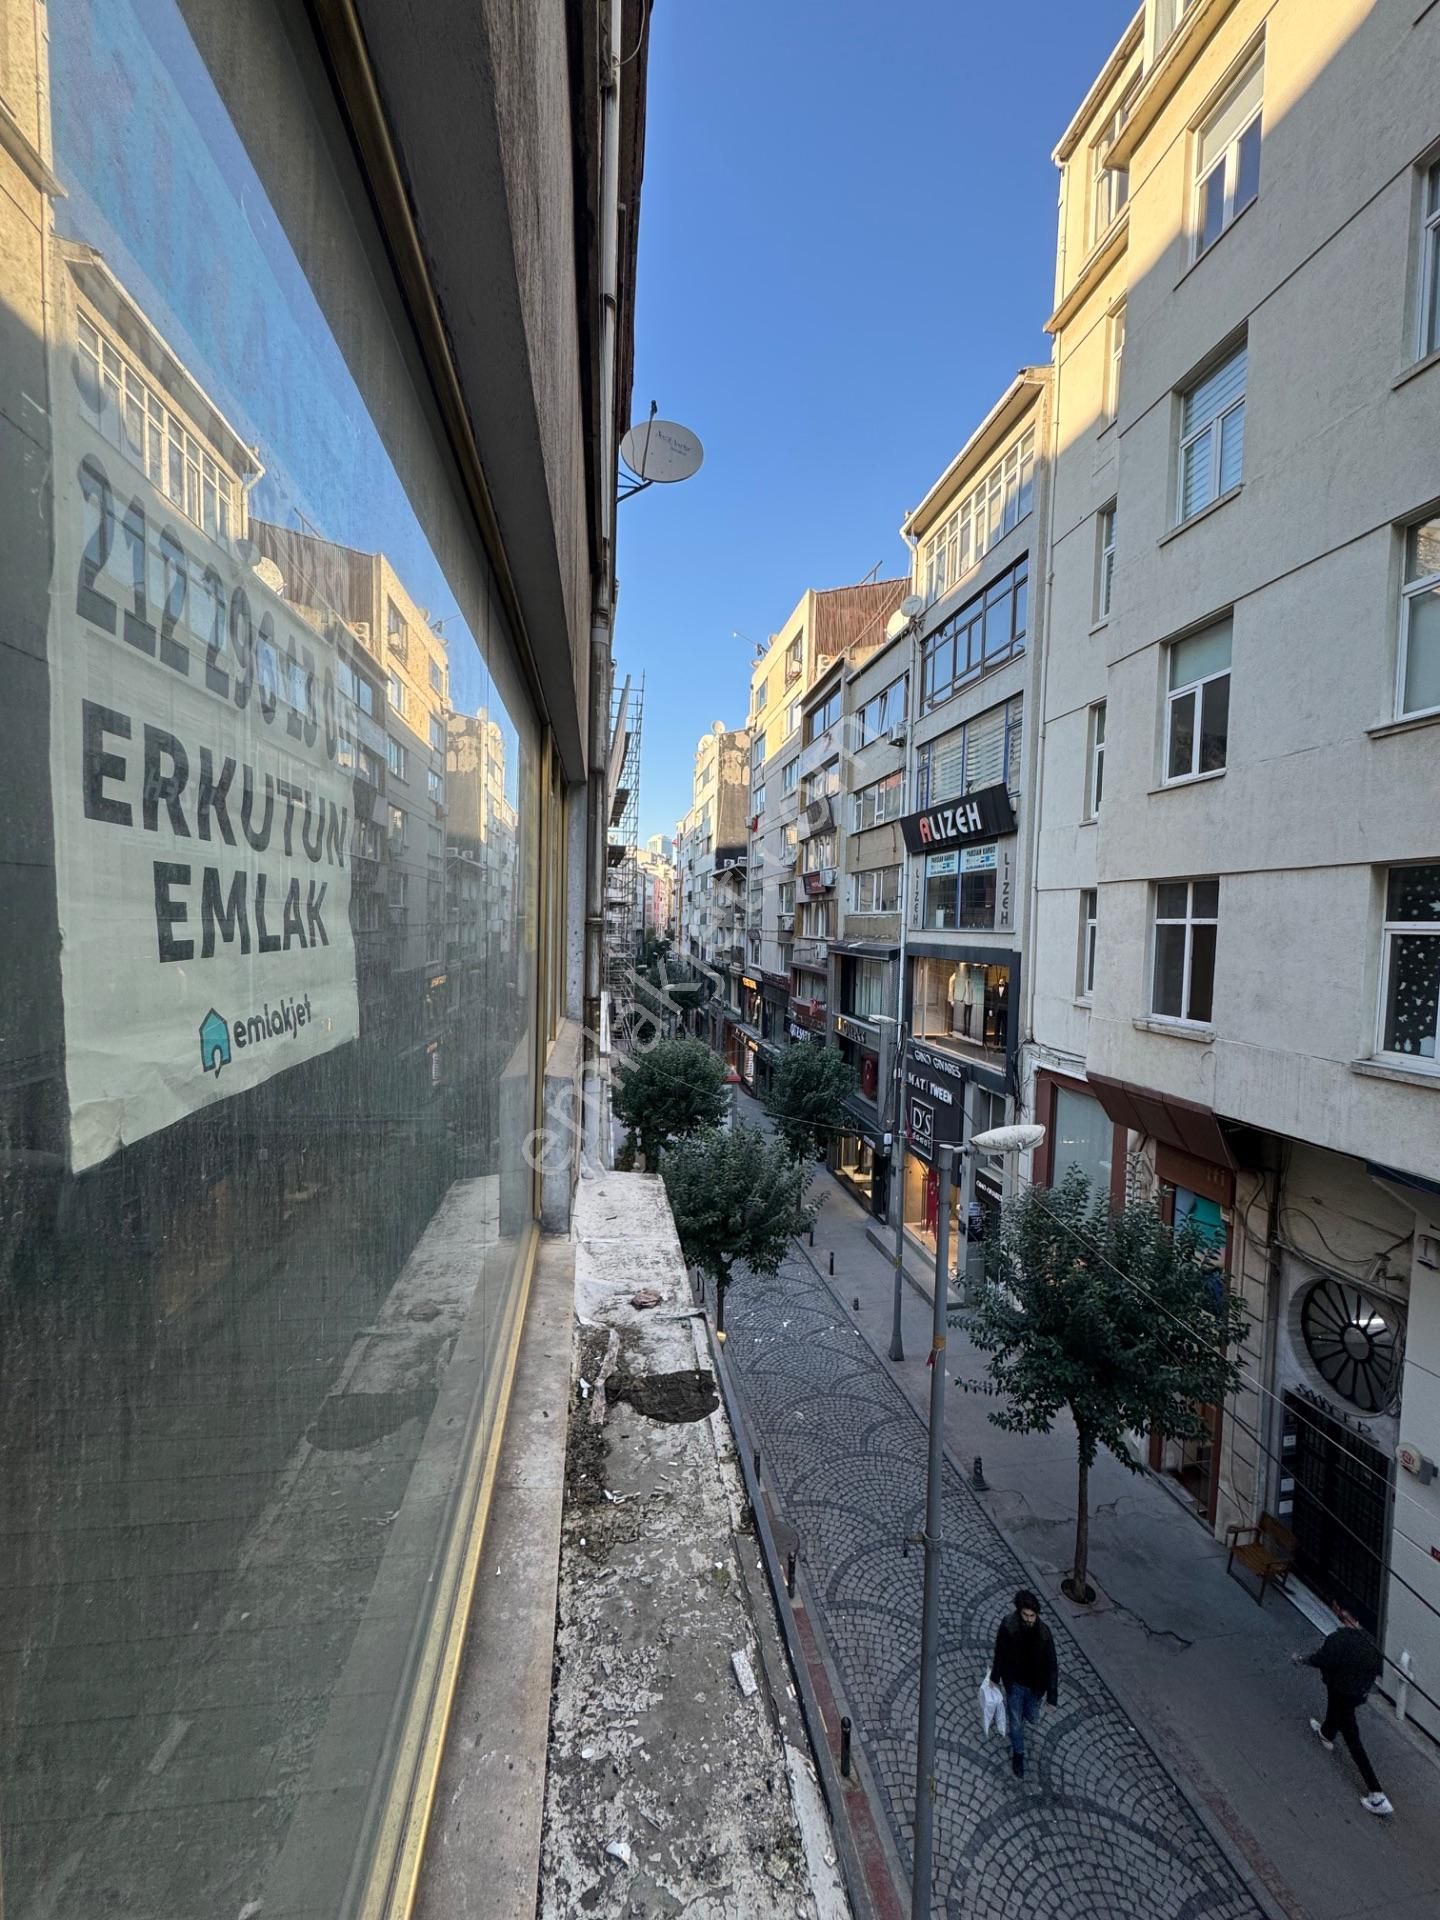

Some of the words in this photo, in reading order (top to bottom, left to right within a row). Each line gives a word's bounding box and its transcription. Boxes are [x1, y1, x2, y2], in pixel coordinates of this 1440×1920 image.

[76, 453, 189, 676] 212
[81, 698, 348, 868] ERKUTUN
[919, 802, 982, 844] ALIZEH
[153, 860, 329, 963] EMLAK
[233, 993, 312, 1049] emlakjet
